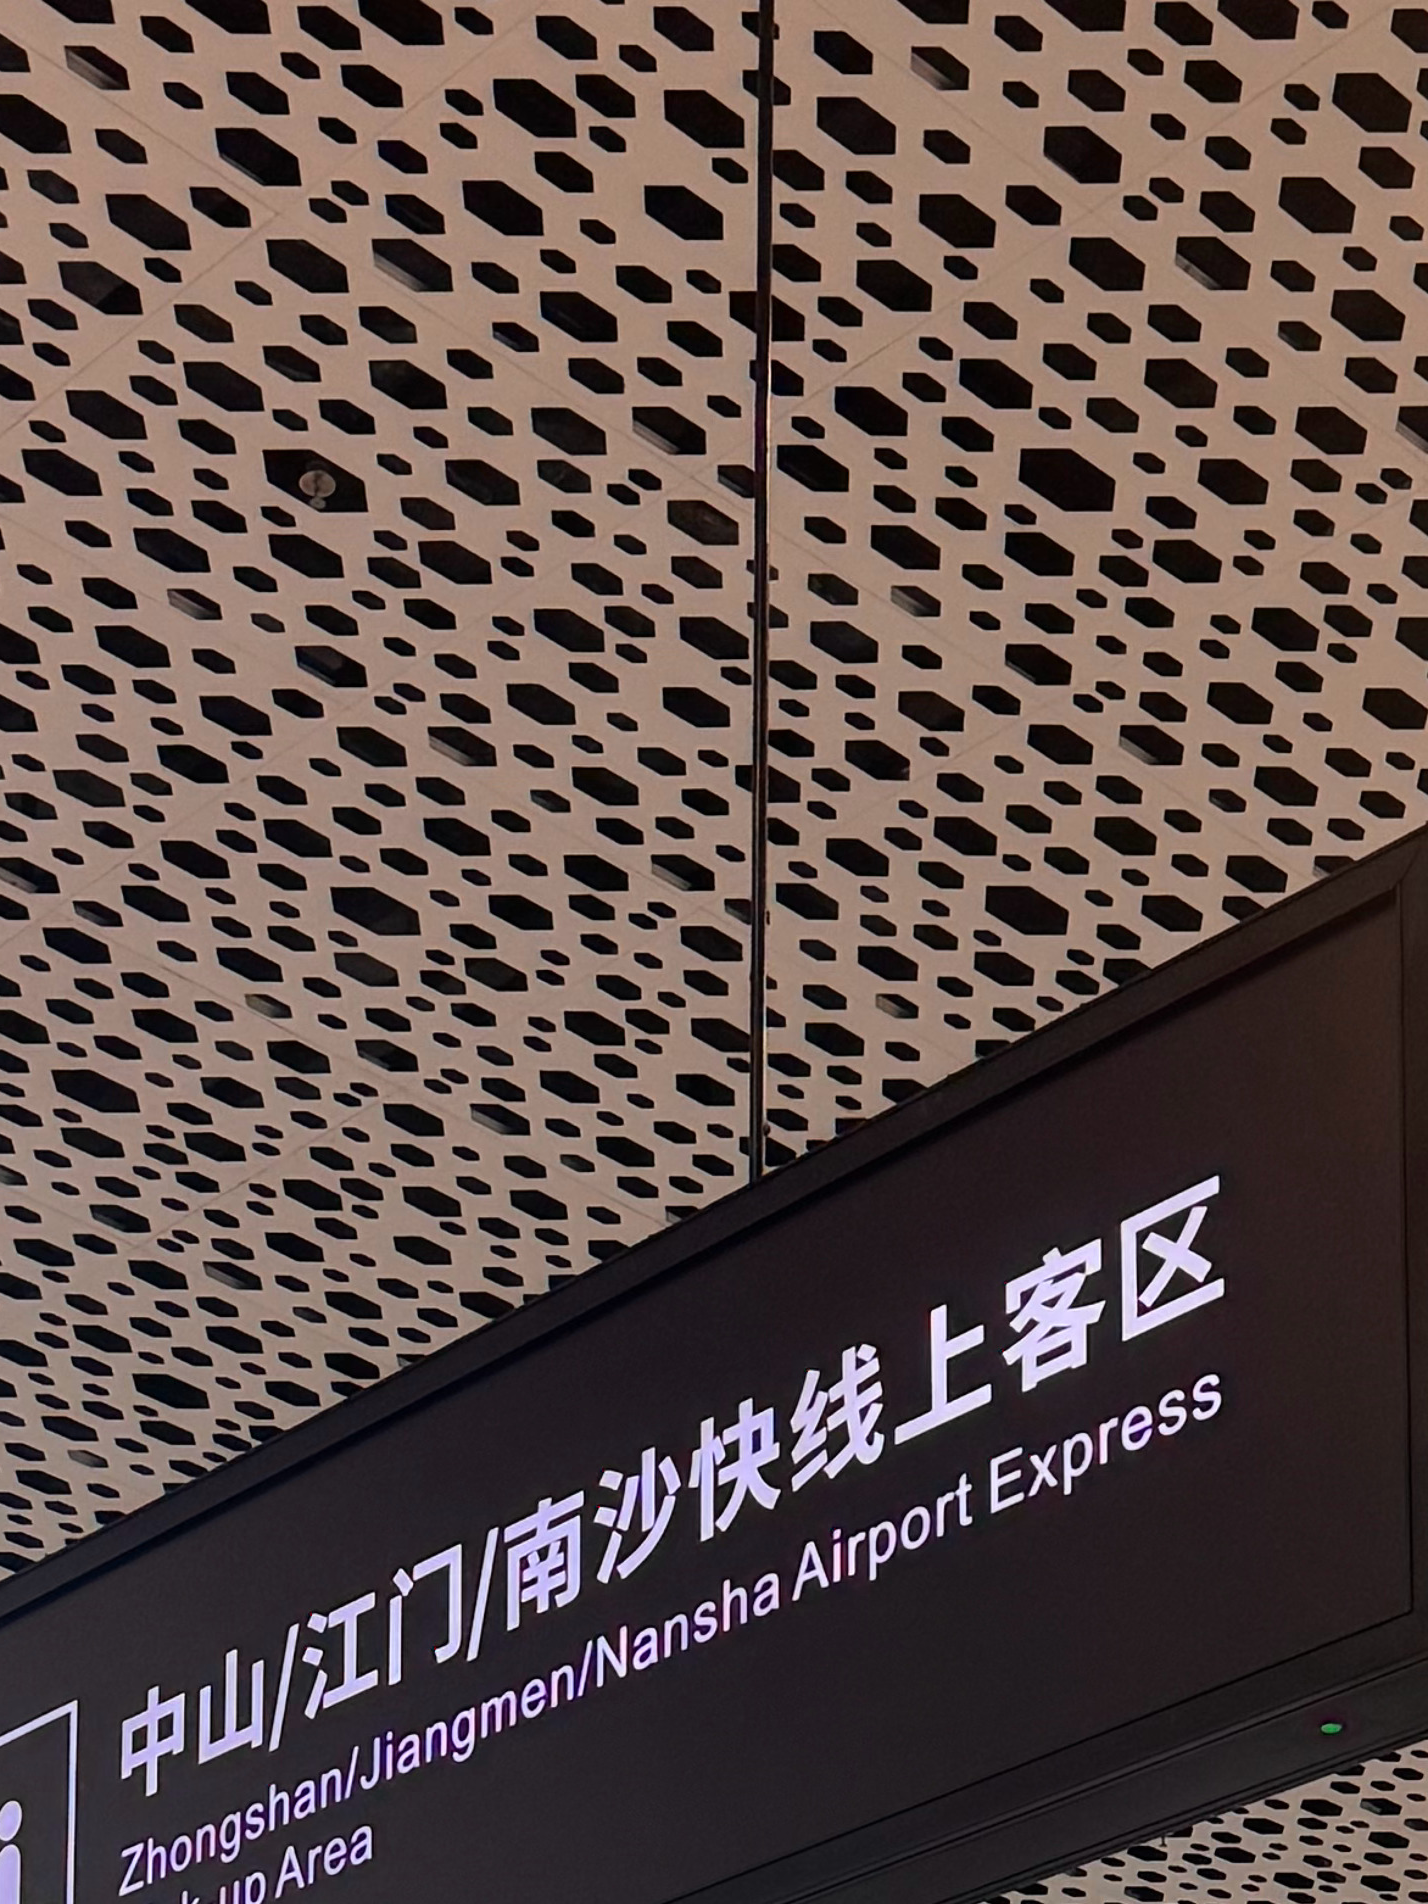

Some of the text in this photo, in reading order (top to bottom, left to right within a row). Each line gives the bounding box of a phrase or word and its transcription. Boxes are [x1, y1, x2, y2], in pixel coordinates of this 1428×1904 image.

[117, 1373, 1224, 1897] Zhongshan/Jiangmen/Nansha Airport Express
[119, 1174, 1226, 1797] 中山/江门/南沙快线上客区
[274, 1825, 374, 1899] Area
